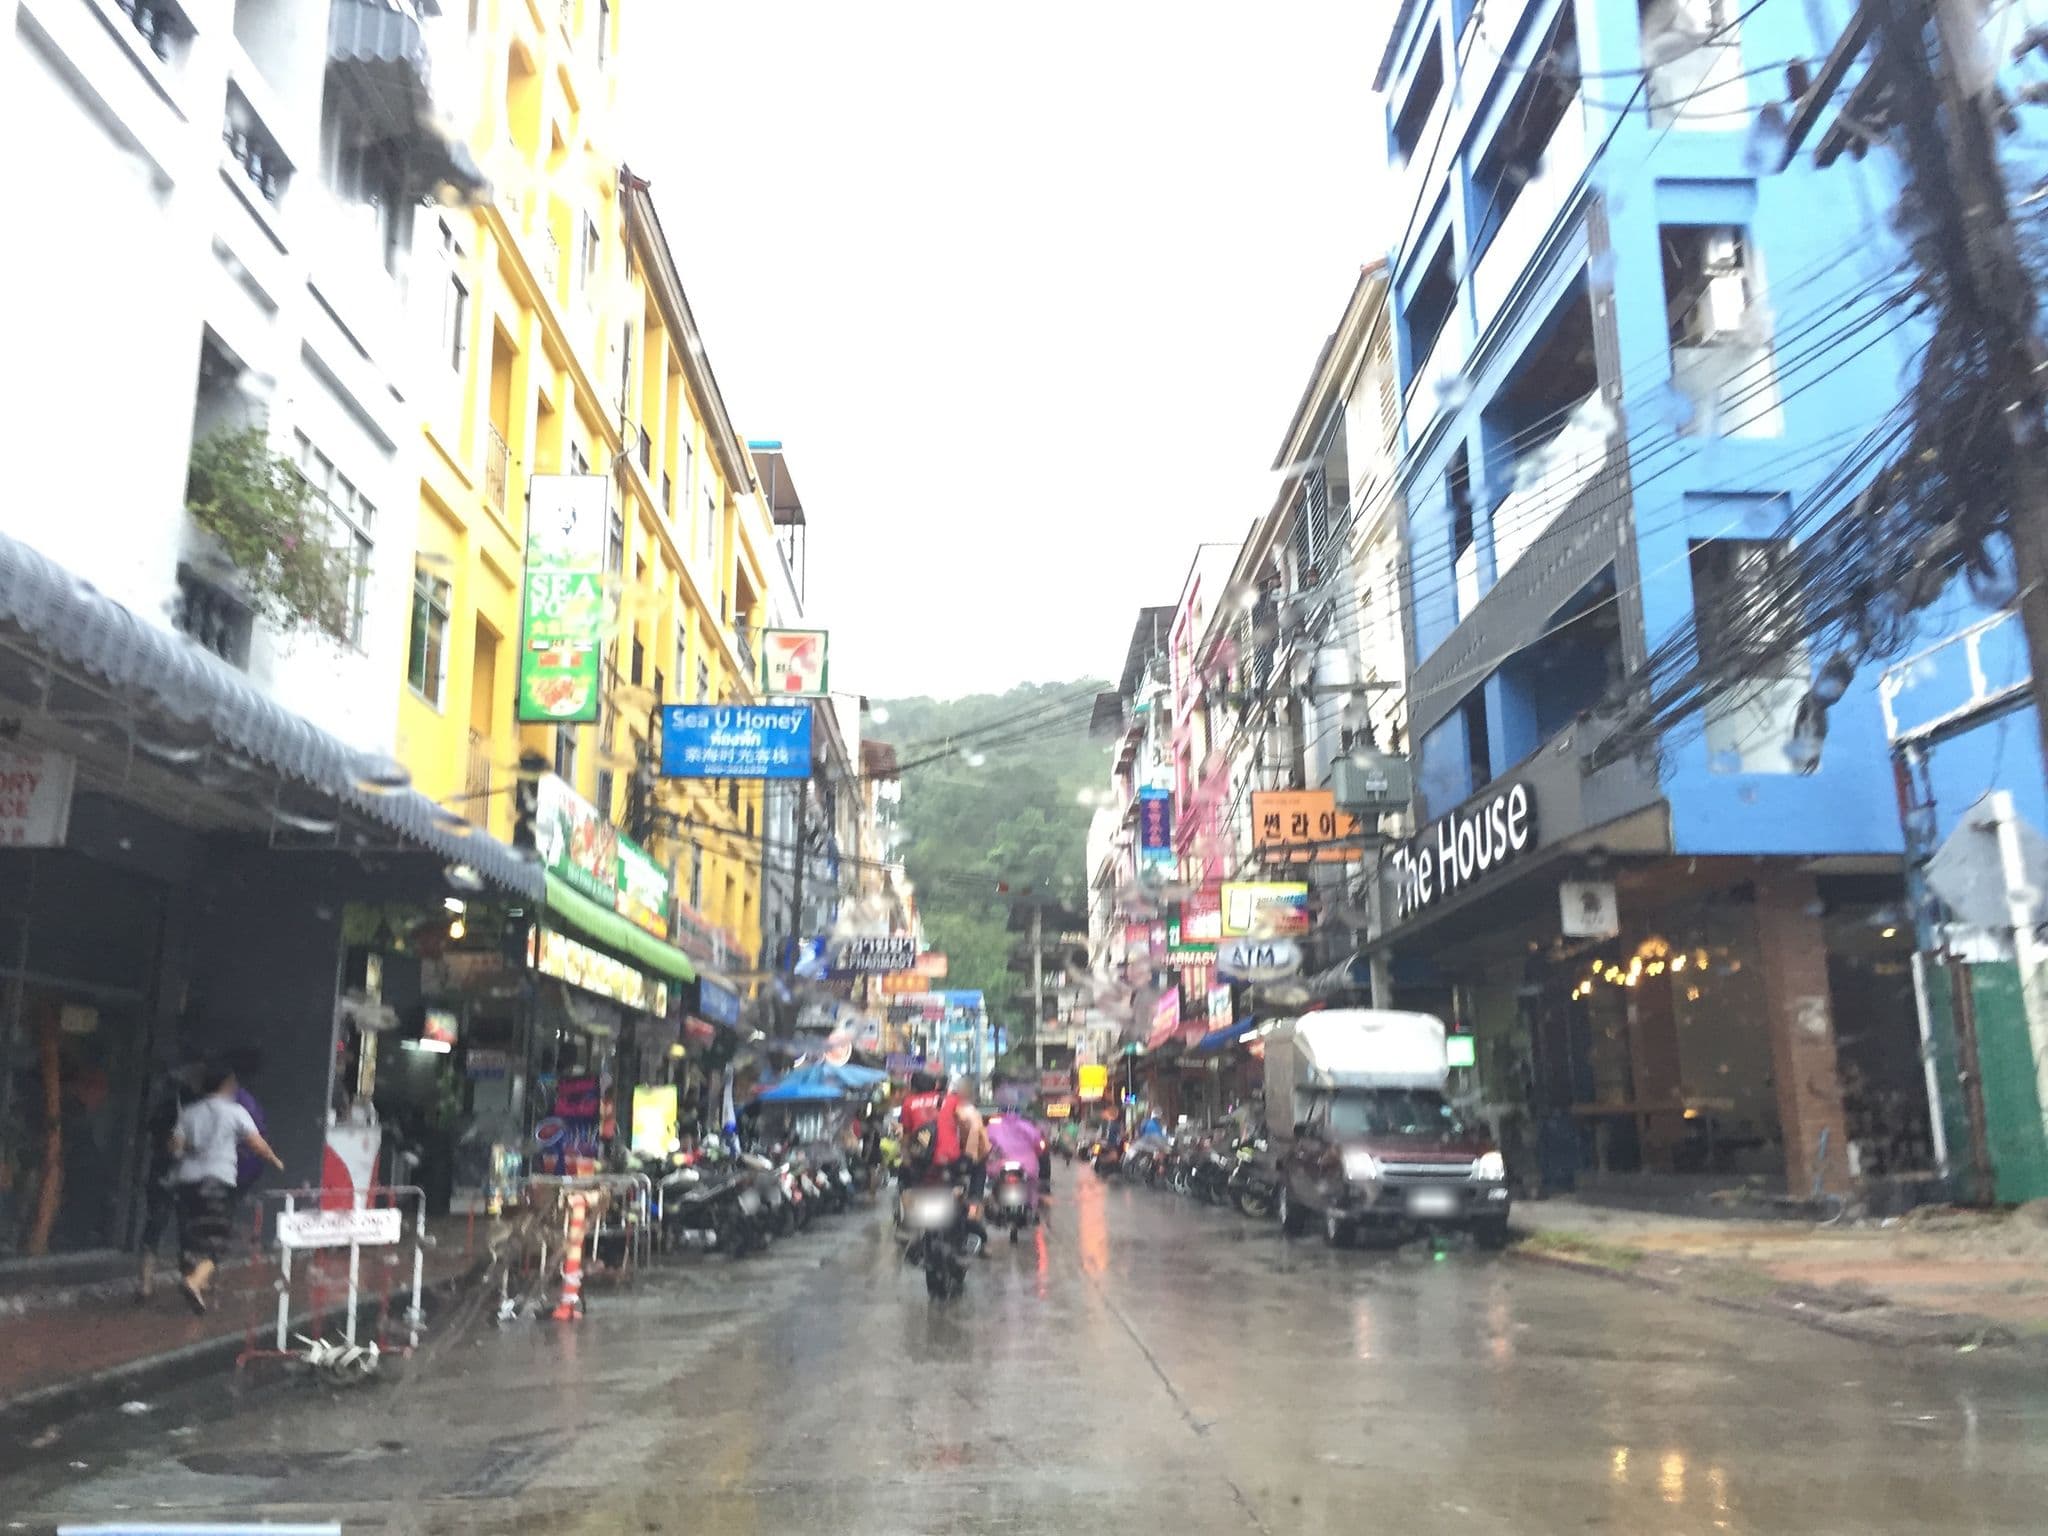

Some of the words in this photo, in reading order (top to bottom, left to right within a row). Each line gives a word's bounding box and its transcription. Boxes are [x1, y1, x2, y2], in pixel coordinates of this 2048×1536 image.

[530, 574, 595, 601] SEA
[672, 709, 709, 730] Sea
[715, 710, 730, 729] U
[736, 710, 802, 734] Honey
[1392, 845, 1433, 918] The
[1437, 783, 1529, 894] House
[849, 953, 913, 969] PHARMACY
[1232, 944, 1276, 969] ATM
